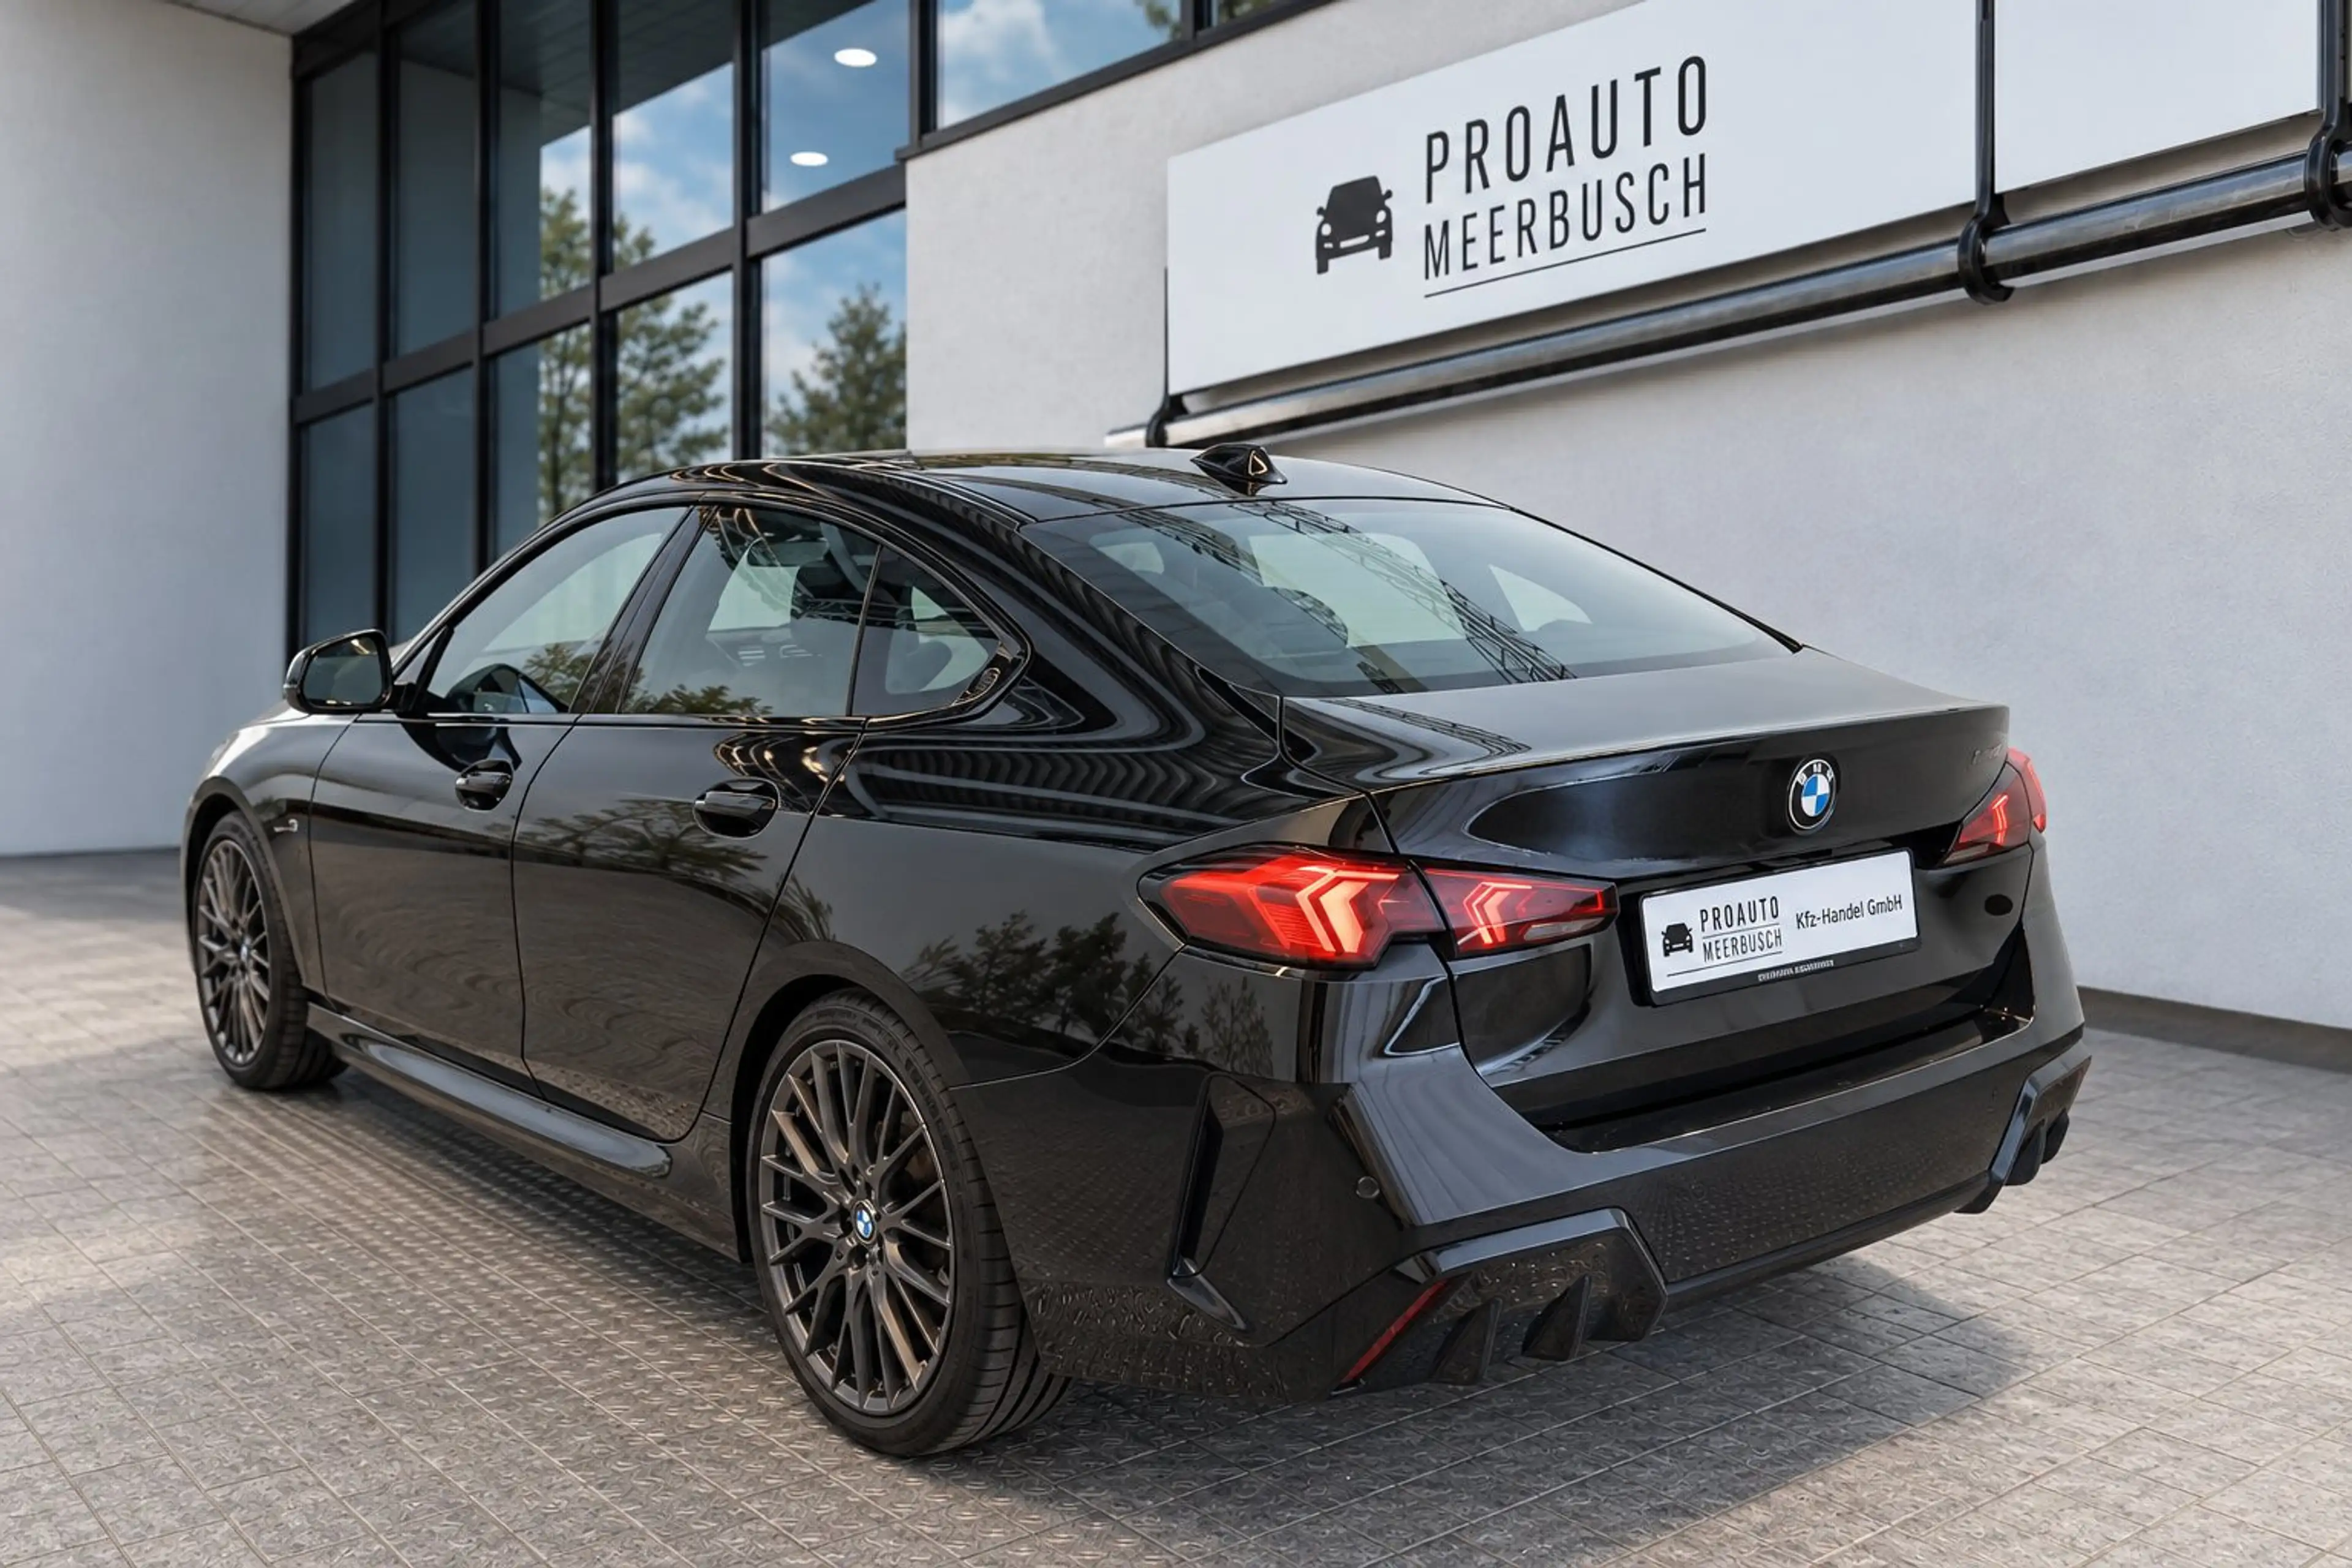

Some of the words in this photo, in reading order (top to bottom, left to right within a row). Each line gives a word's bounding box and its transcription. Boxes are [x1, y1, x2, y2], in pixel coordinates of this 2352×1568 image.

[1425, 56, 1706, 205] PROAUTO
[1424, 153, 1706, 281] MEERBUSCH
[1700, 895, 1780, 932] PROAUTO
[1795, 901, 1865, 930] Kfz-Handel
[1867, 894, 1903, 916] GmbH
[1703, 928, 1783, 963] MEERBUSCH
